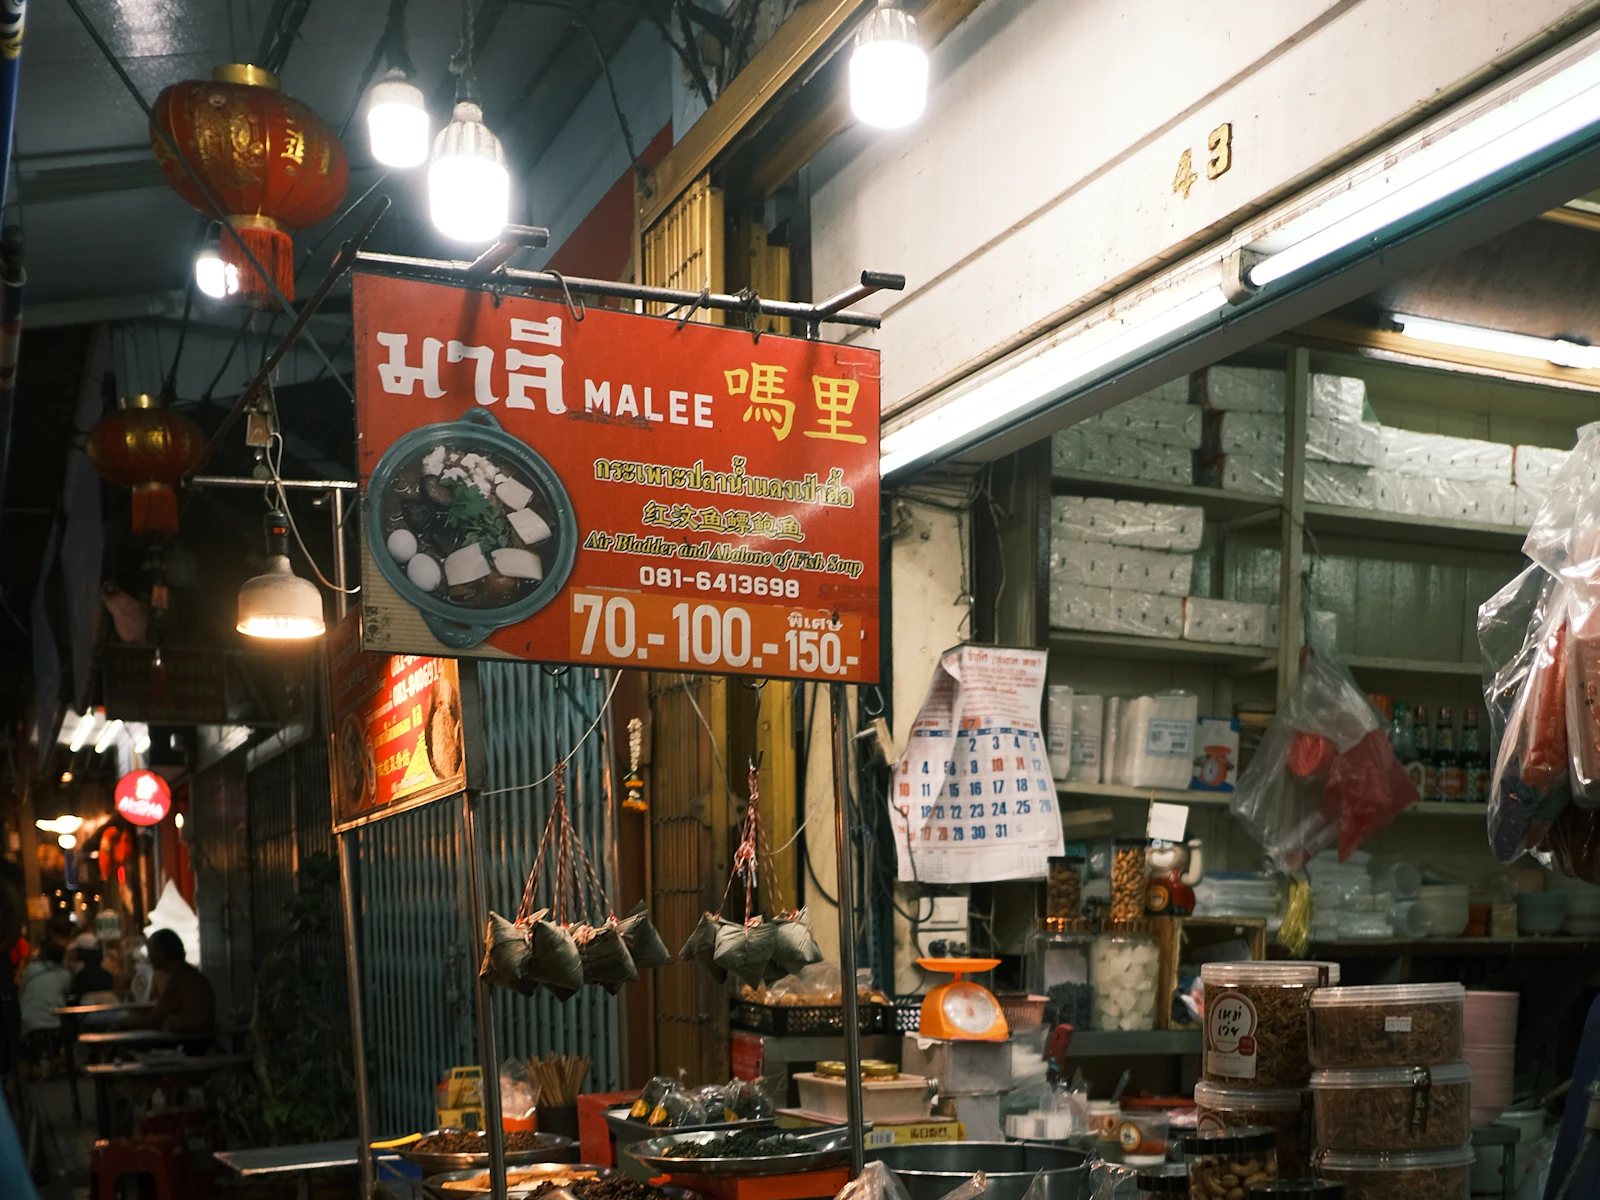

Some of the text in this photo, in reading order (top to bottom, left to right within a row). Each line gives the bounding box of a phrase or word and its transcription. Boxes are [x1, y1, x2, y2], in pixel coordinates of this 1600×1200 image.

[1172, 122, 1232, 200] 43
[377, 317, 569, 415] มาลี
[584, 379, 713, 428] MALEE
[583, 529, 864, 580] Air Bladder and Abalone of Fish Soup
[639, 566, 800, 599] 081-6413698
[573, 593, 779, 668] 70.- 100.-
[784, 629, 859, 675] 150.-
[969, 737, 977, 752] 2
[992, 736, 1001, 750] 3
[1013, 736, 1021, 749] 4
[1029, 737, 1037, 752] 5
[921, 760, 929, 775] 4
[992, 758, 1004, 772] 10
[1016, 756, 1025, 770] 11
[1032, 758, 1042, 772] 12
[900, 782, 931, 797] 10 11
[949, 778, 1047, 798] 15 16 17 18 19
[936, 799, 1052, 819] 21 22 23 24 25 26
[970, 825, 986, 840] 30
[995, 823, 1008, 838] 31
